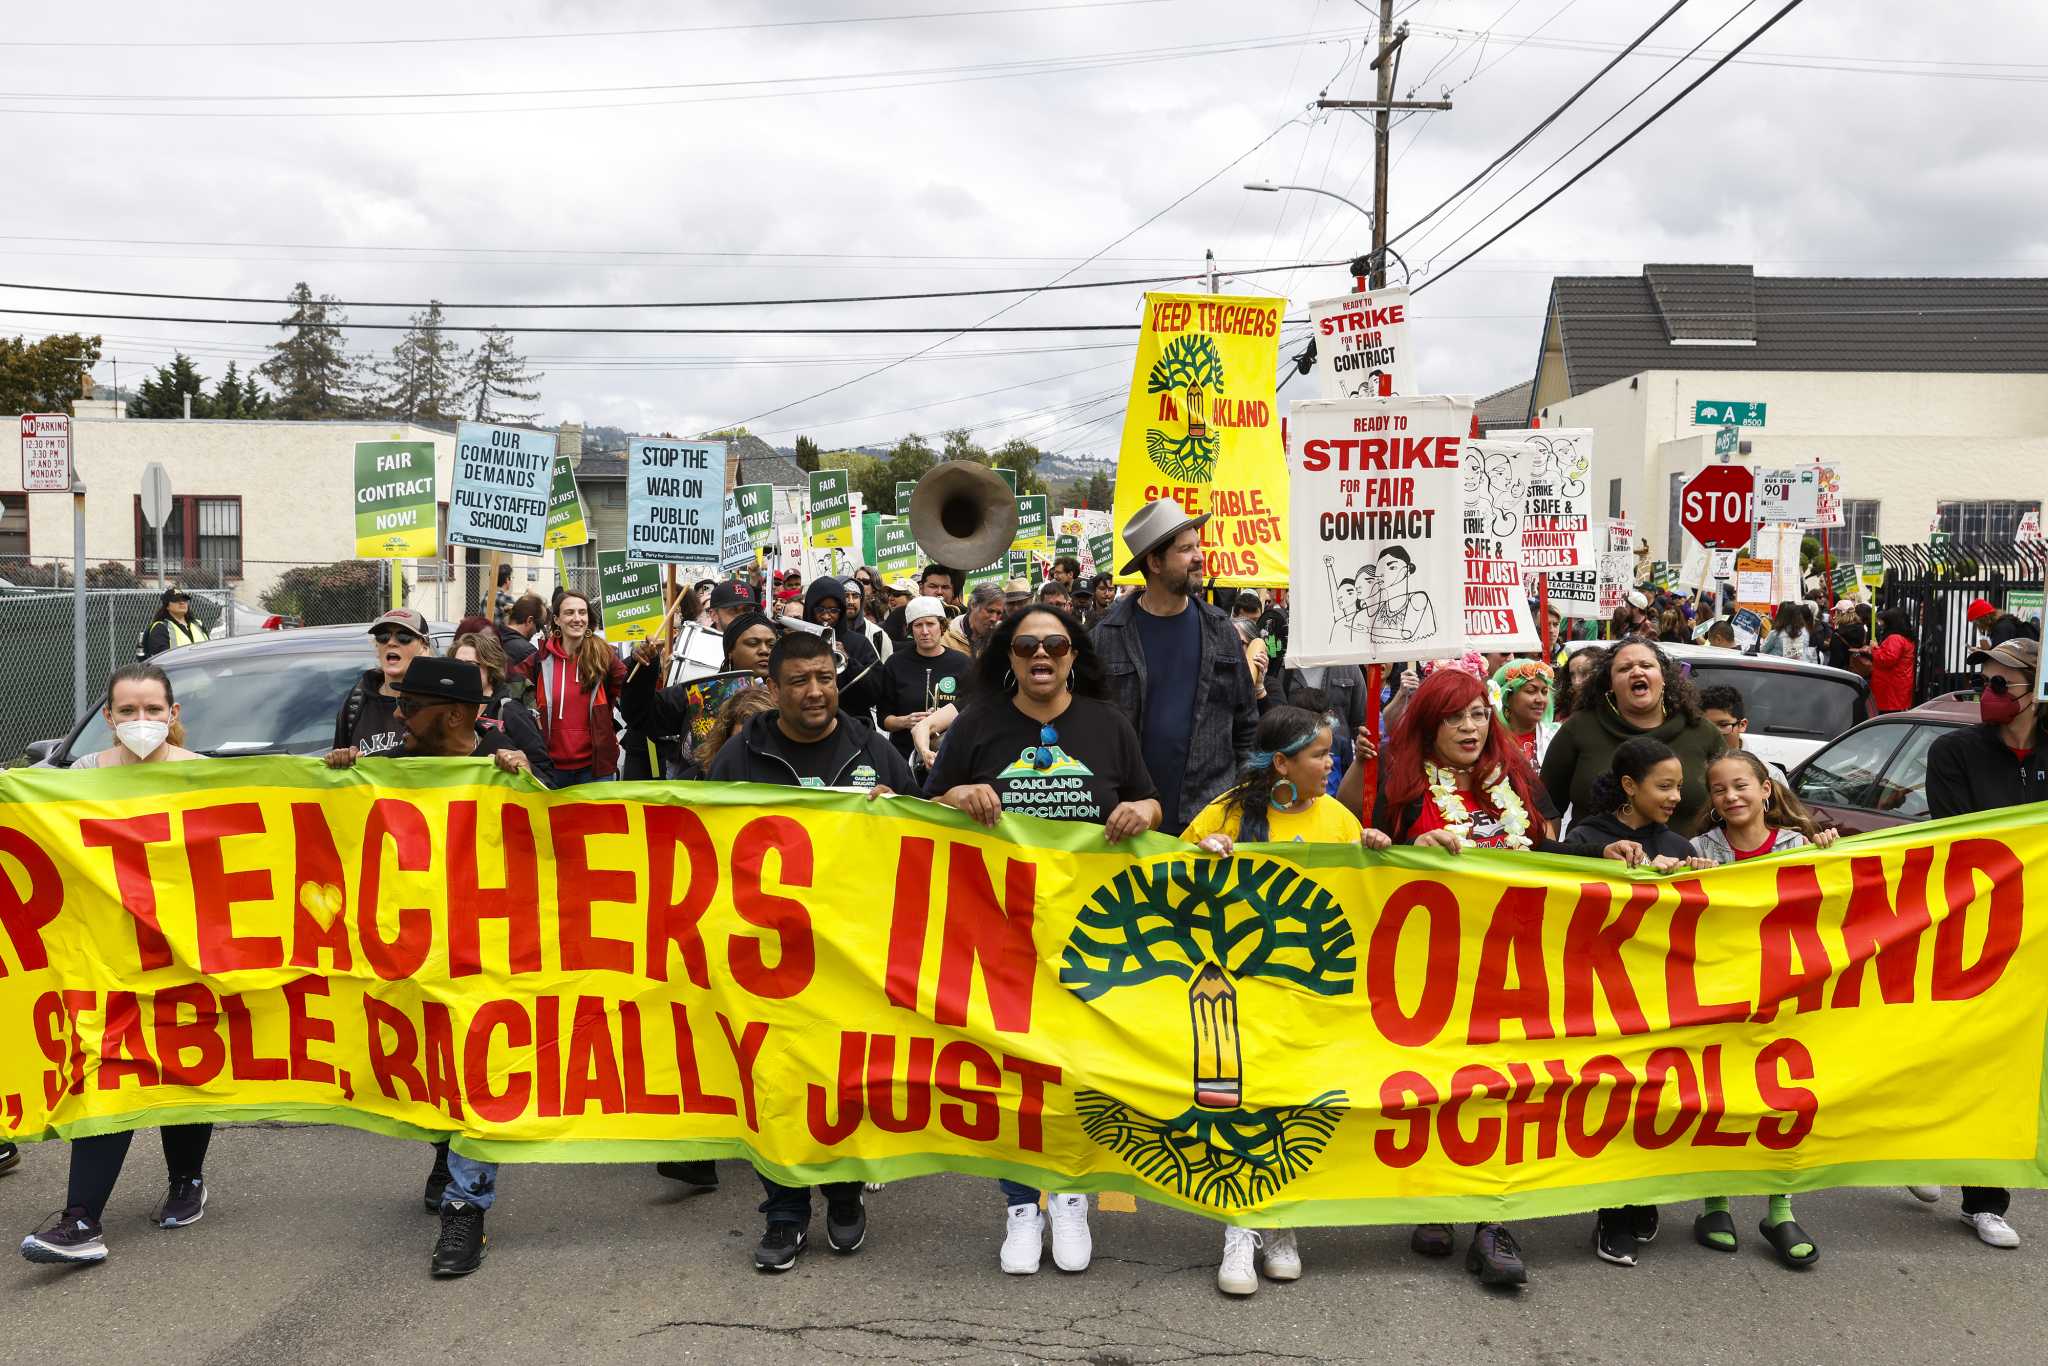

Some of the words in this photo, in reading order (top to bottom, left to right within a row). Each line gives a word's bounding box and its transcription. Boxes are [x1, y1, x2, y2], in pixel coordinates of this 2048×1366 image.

[1342, 299, 1363, 311] READY
[1364, 298, 1372, 306] TO
[1152, 302, 1192, 333] KEEP
[1198, 303, 1277, 338] TEACHERS
[1320, 304, 1405, 336] STRIKE
[1340, 336, 1352, 345] FOR
[1355, 331, 1382, 351] FAIR
[1346, 344, 1350, 352] A
[1334, 346, 1395, 373] CONTRACT
[1158, 393, 1179, 421] IN
[1212, 398, 1269, 428] AKLAND
[1722, 406, 1736, 422] A
[22, 419, 36, 434] NO
[36, 421, 67, 431] PARKING
[1354, 416, 1390, 432] READY
[1394, 415, 1408, 431] TO
[26, 439, 43, 448] 12:30
[46, 440, 55, 448] PM
[58, 440, 65, 448] TO
[492, 430, 520, 450] OUR
[32, 450, 47, 458] 3:30
[50, 450, 59, 458] PM
[376, 452, 412, 472] FAIR
[460, 444, 550, 472] COMMUNITY
[642, 446, 679, 467] STOP
[681, 448, 708, 469] THE
[1302, 436, 1461, 472] STRIKE
[38, 460, 52, 468] AND
[553, 465, 567, 477] BLE
[31, 470, 62, 478] MONDAYS
[464, 464, 535, 488] DEMANDS
[358, 478, 432, 503] CONTRACT
[647, 476, 680, 498] WAR
[682, 480, 702, 498] ON
[818, 478, 836, 492] FAIR
[1340, 479, 1360, 493] FOR
[1365, 477, 1415, 508] FAIR
[1526, 484, 1553, 498] STRIKE
[1764, 484, 1780, 496] 90
[455, 490, 492, 510] FULLY
[494, 495, 546, 516] STAFFED
[558, 490, 576, 504] JUST
[725, 498, 733, 512] OP
[741, 491, 758, 508] ON
[812, 494, 847, 513] CONTRACT
[1020, 500, 1032, 511] ON
[1345, 493, 1352, 508] A
[1534, 499, 1560, 514] SAFE
[1564, 500, 1572, 514] &
[376, 510, 417, 530] NOW!
[470, 510, 528, 534] SCHOOLS!
[548, 511, 570, 526] HOOLS
[650, 506, 699, 526] PUBLIC
[742, 510, 770, 528] TRIKE
[821, 516, 841, 530] NOW!
[1018, 512, 1042, 525] TRIKE
[1523, 515, 1552, 532] ALLY
[1554, 515, 1584, 531] JUST
[1232, 516, 1282, 547] JUST
[1320, 509, 1436, 542] CONTRACT
[634, 525, 714, 546] EDUCATION!
[724, 530, 746, 548] PUBLIC
[886, 530, 904, 541] FAIR
[1522, 532, 1576, 548] MMUNITY
[722, 541, 752, 560] DUCATION
[878, 542, 915, 558] CONTRACT
[1464, 538, 1491, 560] SAFE
[1494, 541, 1503, 560] &
[1868, 542, 1876, 550] ON
[1009, 550, 1028, 560] TRIKE
[1202, 550, 1259, 577] OOLS
[1521, 550, 1572, 567] CHOOLS
[1864, 554, 1882, 563] STRIKE
[604, 564, 624, 576] SAFE,
[625, 562, 649, 571] STAB
[888, 560, 908, 570] NOW!
[1486, 562, 1517, 584] JUST
[622, 574, 638, 585] AND
[1548, 571, 1596, 584] KEEP
[606, 588, 640, 604] RACIALLY
[640, 584, 658, 596] JUST
[1548, 582, 1584, 591] TEACHERS
[1548, 589, 1594, 600] OAKLAND
[1465, 586, 1510, 607] MUNITY
[616, 604, 651, 620] SCHOOLS
[1464, 610, 1510, 634] HOOLS
[1010, 778, 1084, 790] OAKLAND
[1002, 790, 1092, 804] EDUCATION
[1004, 806, 1100, 818] SSOCIATION
[79, 798, 815, 999] TEACHERS
[884, 836, 1038, 1033] IN
[1366, 838, 2025, 1047] OAKLAND
[33, 975, 354, 1113] STABLE,
[363, 992, 769, 1134] RACIALLY
[806, 1030, 1062, 1153] JUST
[1373, 1037, 1819, 1169] SCHOOLS
